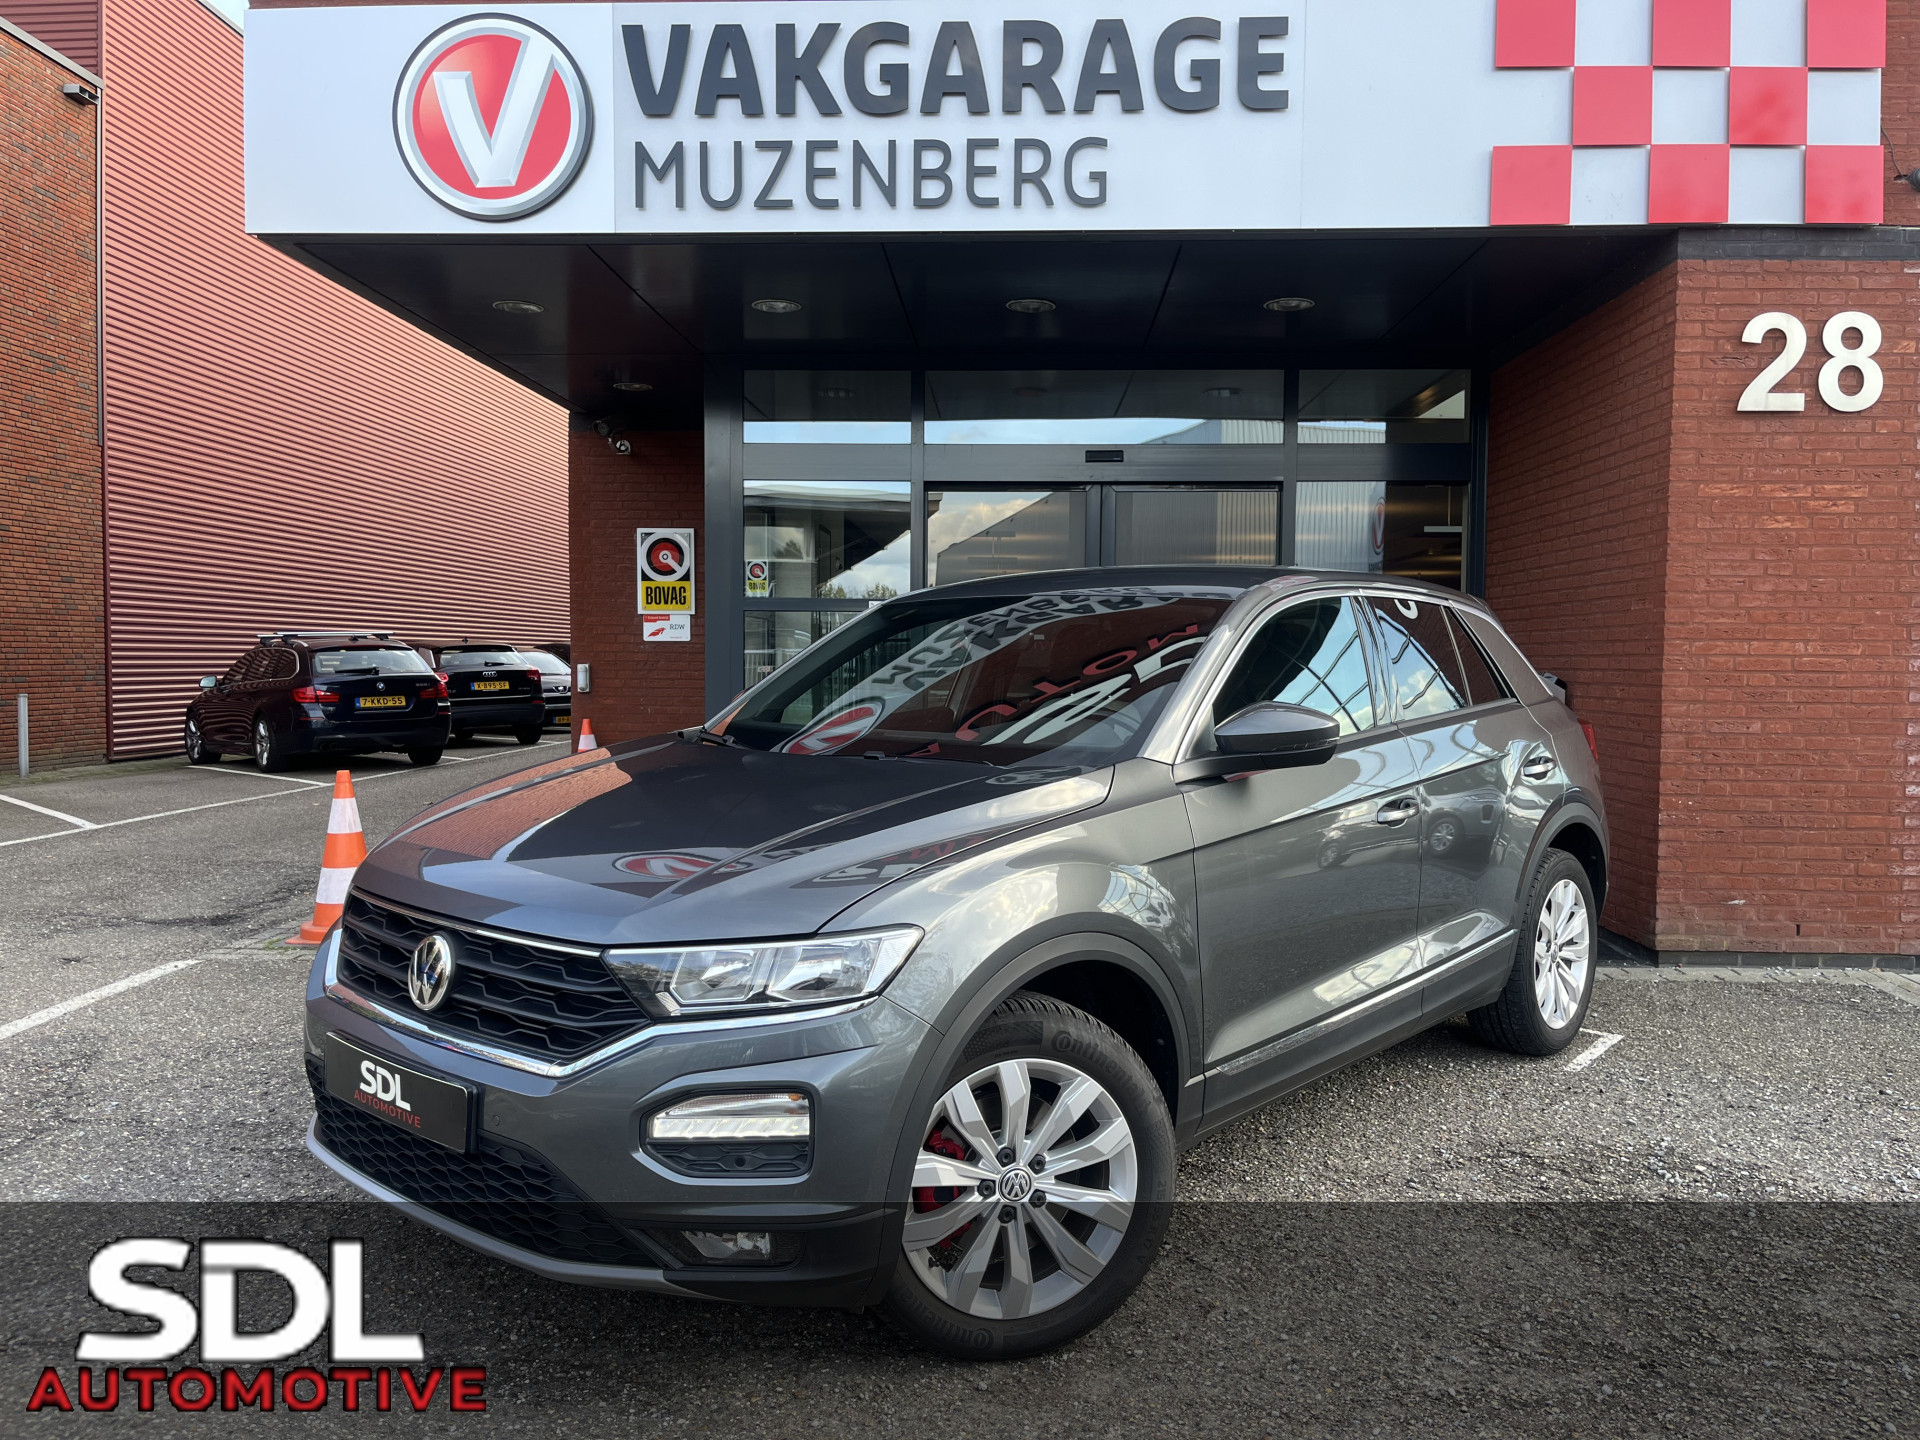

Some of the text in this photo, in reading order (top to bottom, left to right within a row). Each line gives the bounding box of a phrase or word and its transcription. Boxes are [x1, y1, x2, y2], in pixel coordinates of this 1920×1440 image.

[621, 16, 1290, 118] VAKGARAGE
[634, 136, 1109, 210] MUZENBERG
[1737, 311, 1884, 412] 28
[645, 585, 687, 605] BOVAG
[361, 697, 403, 706] 7-KKD-55
[354, 1089, 421, 1128] AUTOMOTIVE
[360, 1060, 411, 1111] SDL
